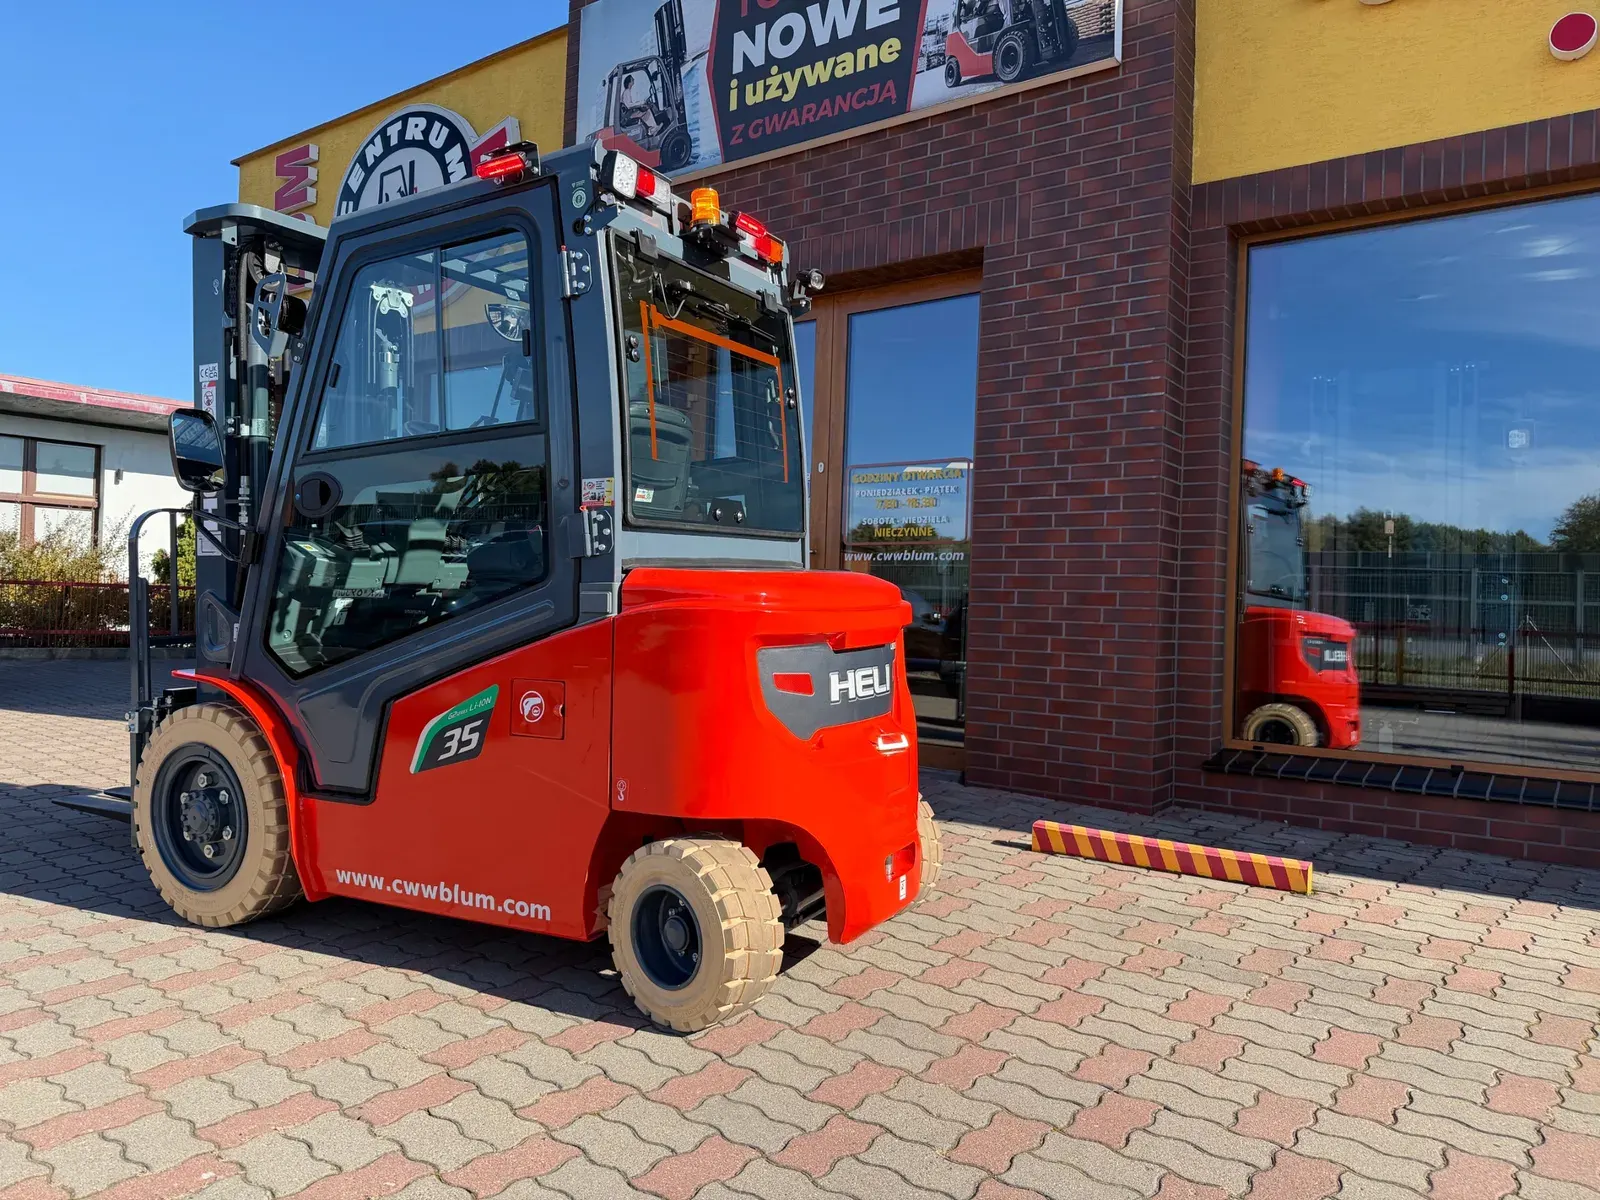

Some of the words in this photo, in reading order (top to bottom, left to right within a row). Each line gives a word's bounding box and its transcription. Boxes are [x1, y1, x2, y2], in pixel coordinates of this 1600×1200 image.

[732, 0, 901, 75] NOWE
[729, 79, 738, 112] i
[745, 36, 902, 106] używane
[729, 123, 746, 146] Z
[748, 79, 898, 139] GWARANCJĄ
[924, 485, 957, 496] PIĄTEK
[861, 517, 895, 526] SOBOTA
[901, 515, 948, 525] NIEDZIELA
[874, 527, 934, 538] NIECZYNNE
[844, 550, 965, 562] www.cwwblum.com
[829, 664, 891, 706] HELI
[437, 719, 484, 762] 35
[335, 868, 551, 921] www.cwwblum.com
